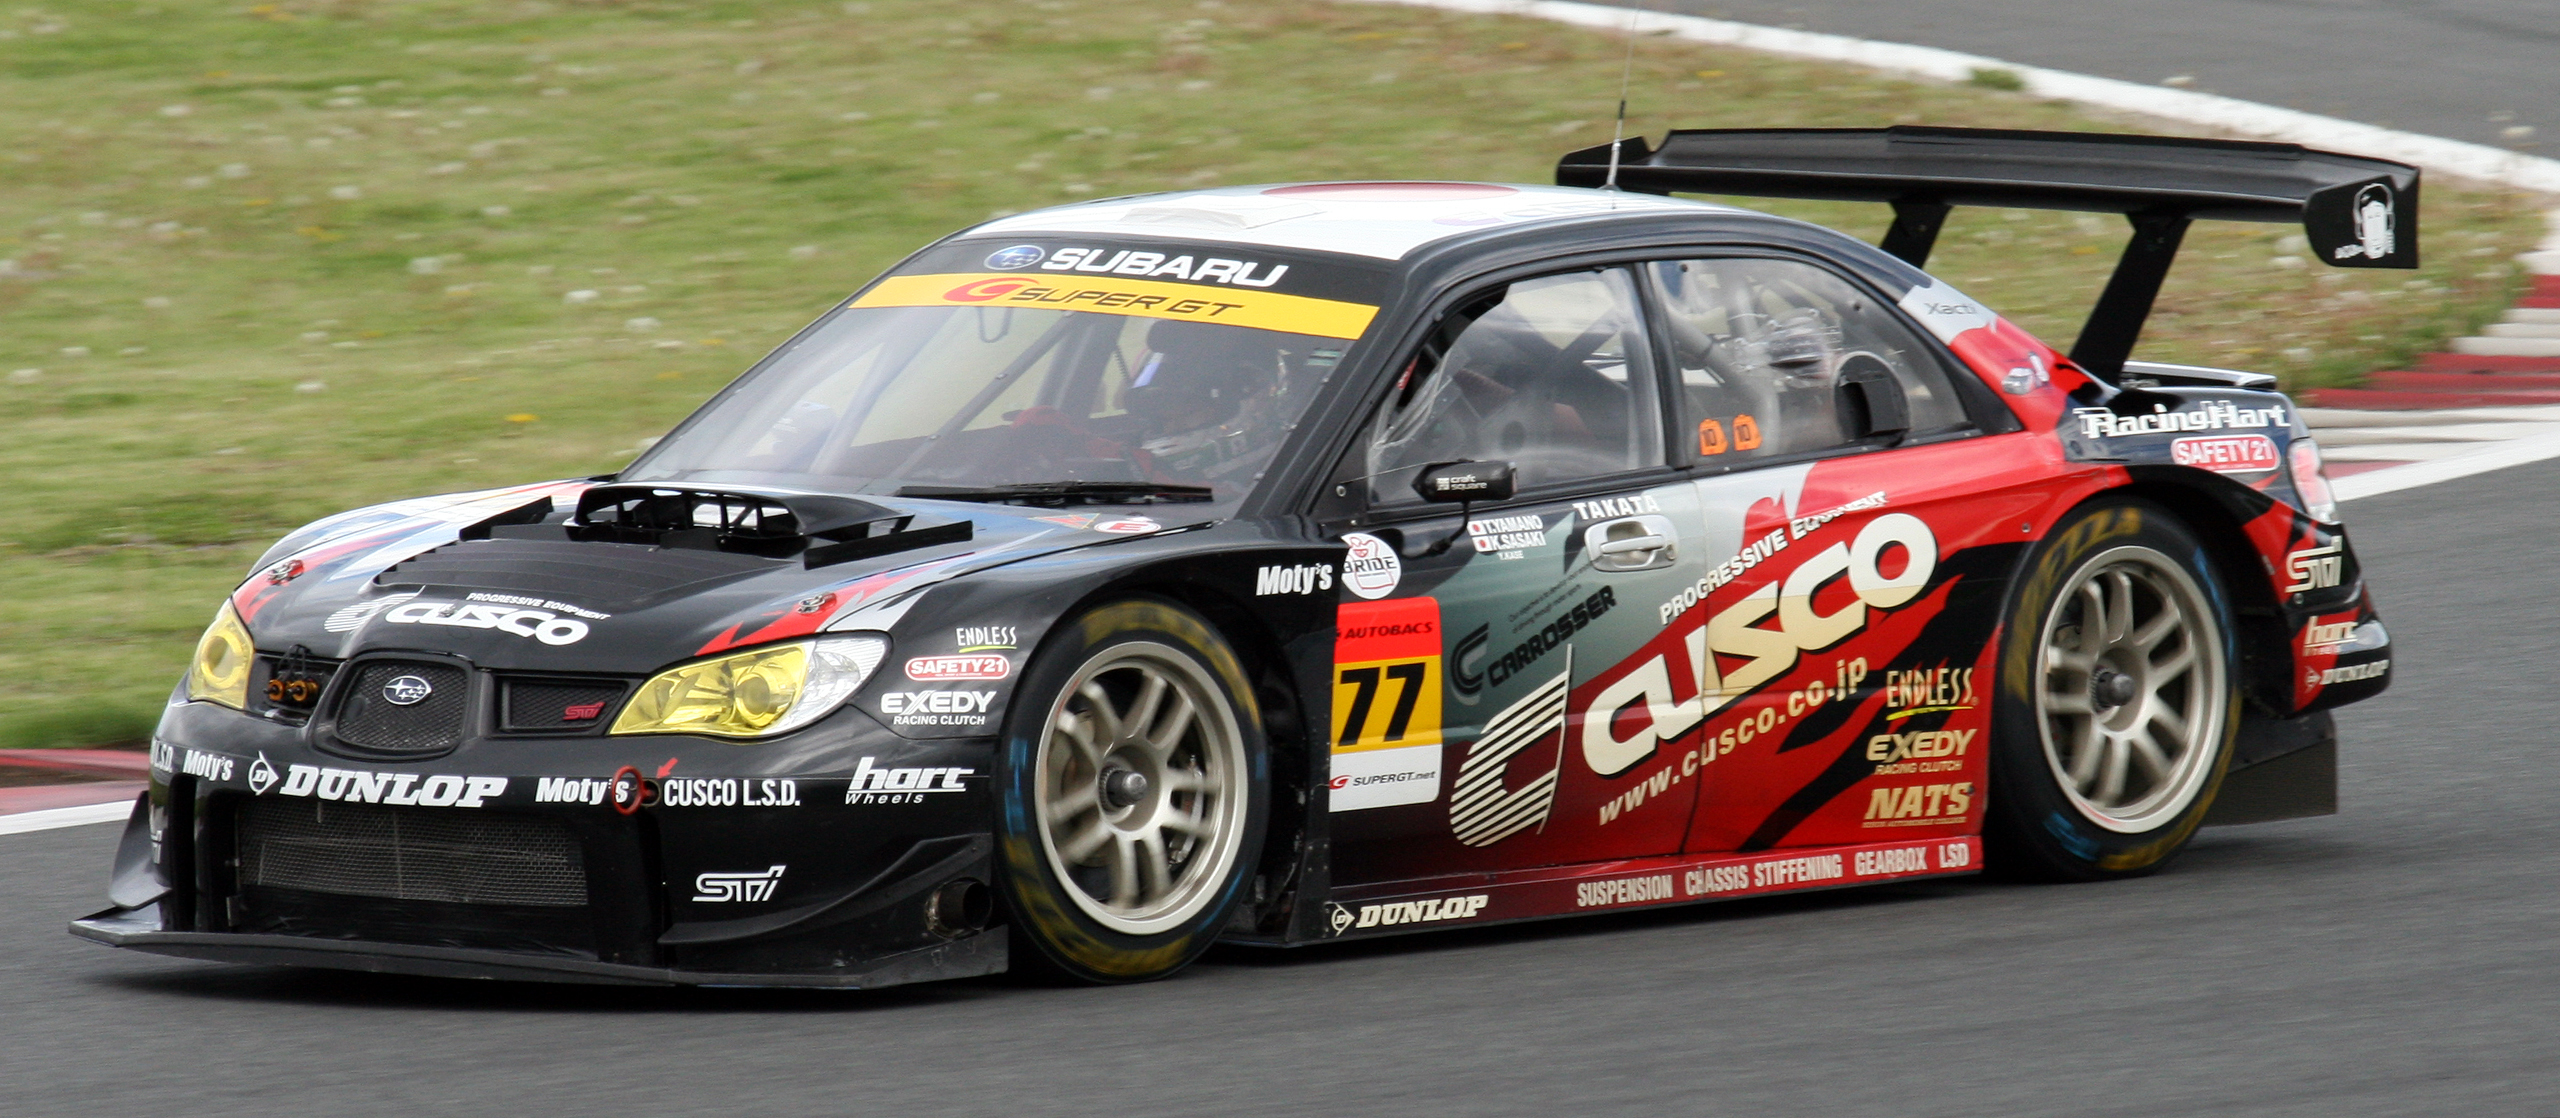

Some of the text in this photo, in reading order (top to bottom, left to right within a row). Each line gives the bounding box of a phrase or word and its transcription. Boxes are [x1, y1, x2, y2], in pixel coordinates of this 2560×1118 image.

[1041, 247, 1288, 287] SUBARU
[1010, 287, 1245, 317] SUPER GT
[1451, 474, 1476, 483] craft
[1451, 481, 1487, 491] square
[1572, 496, 1661, 520] TAKATA
[1256, 562, 1333, 596] Moty's
[1343, 556, 1397, 574] BRIDE
[1659, 528, 1788, 625] PROGRESSIVE
[466, 592, 611, 620] PROGRESSIVE EQUIPMENT
[385, 601, 589, 646] CUSCO
[956, 626, 1017, 646] ENDLESS
[1344, 621, 1433, 639] AUTOBACS
[1487, 585, 1617, 687] CARROSSER
[1582, 513, 1938, 775] CUSCO
[880, 689, 997, 715] EXEDY
[1338, 662, 1426, 746] 77
[1886, 667, 1973, 708] ENDLESS
[893, 715, 985, 726] RACING CLUTCH
[1599, 657, 1868, 826] www.cusco.co.jp
[1866, 729, 1978, 763] EXEDY
[183, 749, 234, 782] Moty's
[846, 756, 975, 793] hart
[1353, 771, 1436, 787] SUPERGT.net
[1874, 760, 1963, 775] RACING CLUTCH
[279, 764, 508, 808] DUNLOP
[535, 777, 630, 805] Moty's
[664, 779, 801, 807] CUSCO L.S.D.
[844, 792, 924, 805] Wheels
[1864, 782, 1973, 819] NATS
[1577, 843, 1970, 907] SUSPENSION CHASSIS STIFFENING GEARBOX LSD
[1356, 894, 1489, 929] DUNLOP
